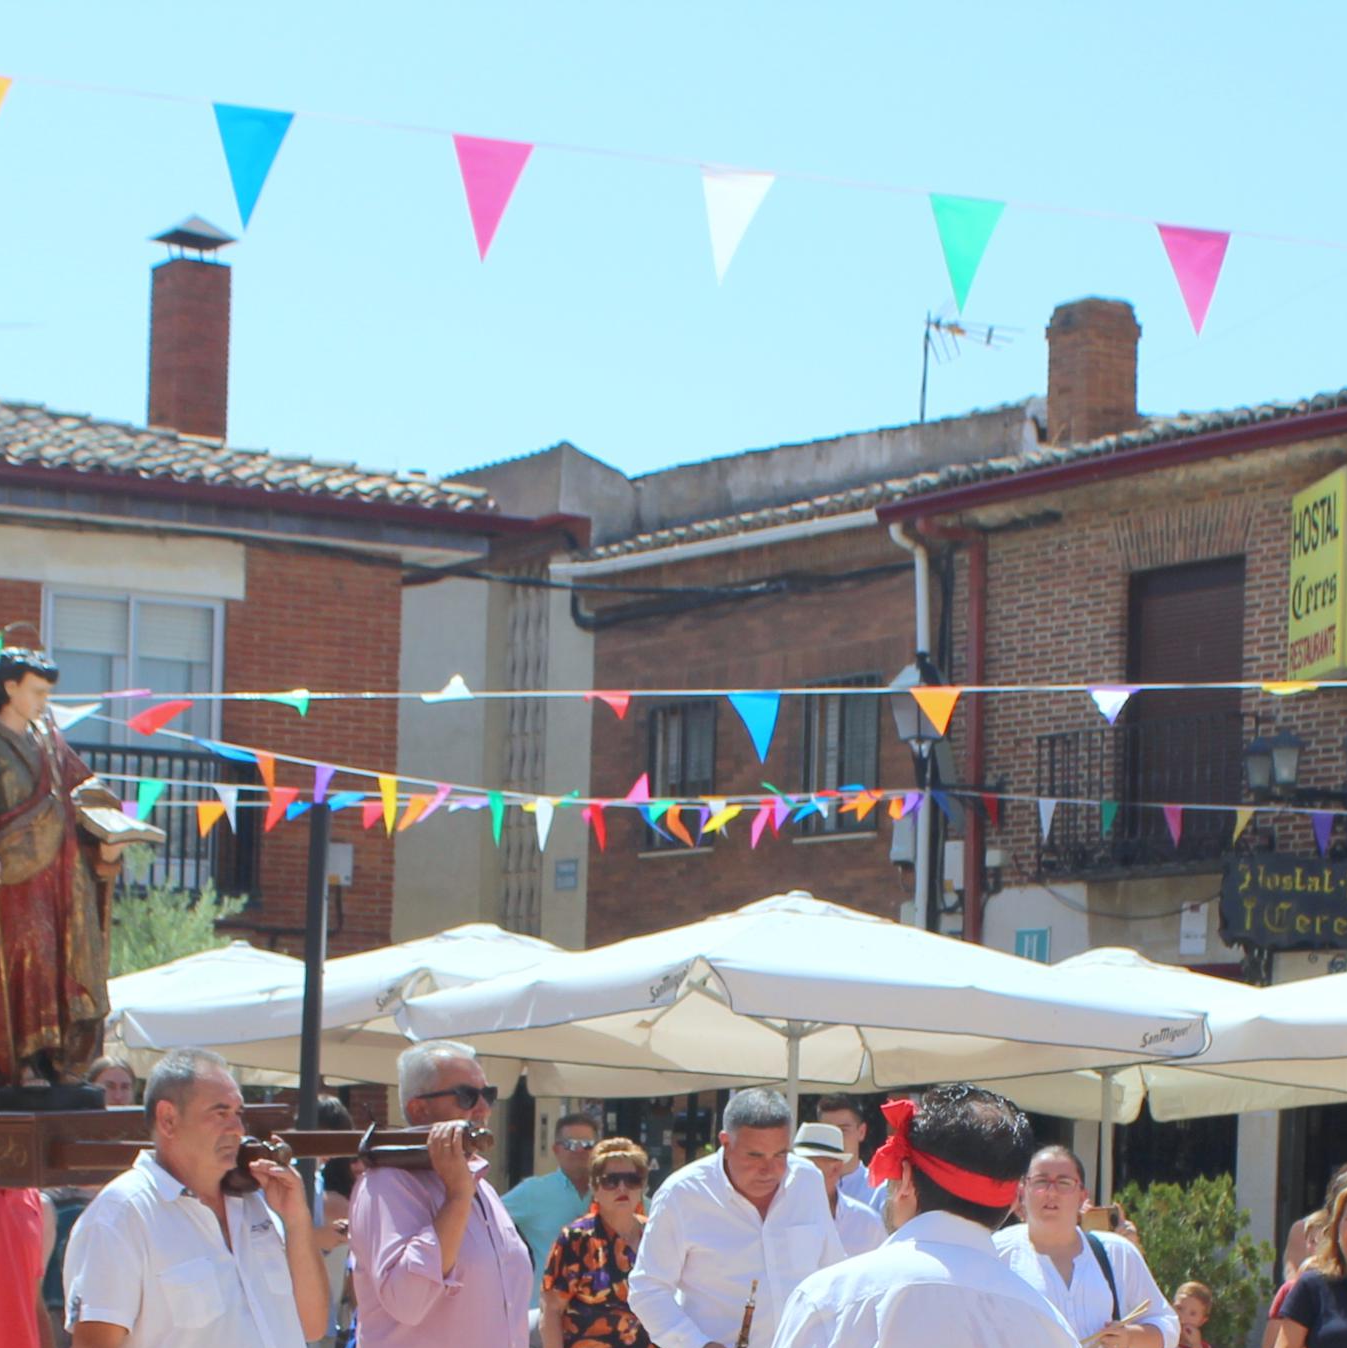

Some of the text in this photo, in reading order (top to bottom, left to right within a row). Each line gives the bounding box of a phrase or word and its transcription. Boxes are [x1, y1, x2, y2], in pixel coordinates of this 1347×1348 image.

[1292, 491, 1339, 560] HOSTAL
[1292, 572, 1338, 621] Ceres
[1289, 625, 1337, 671] RESTAURANTE
